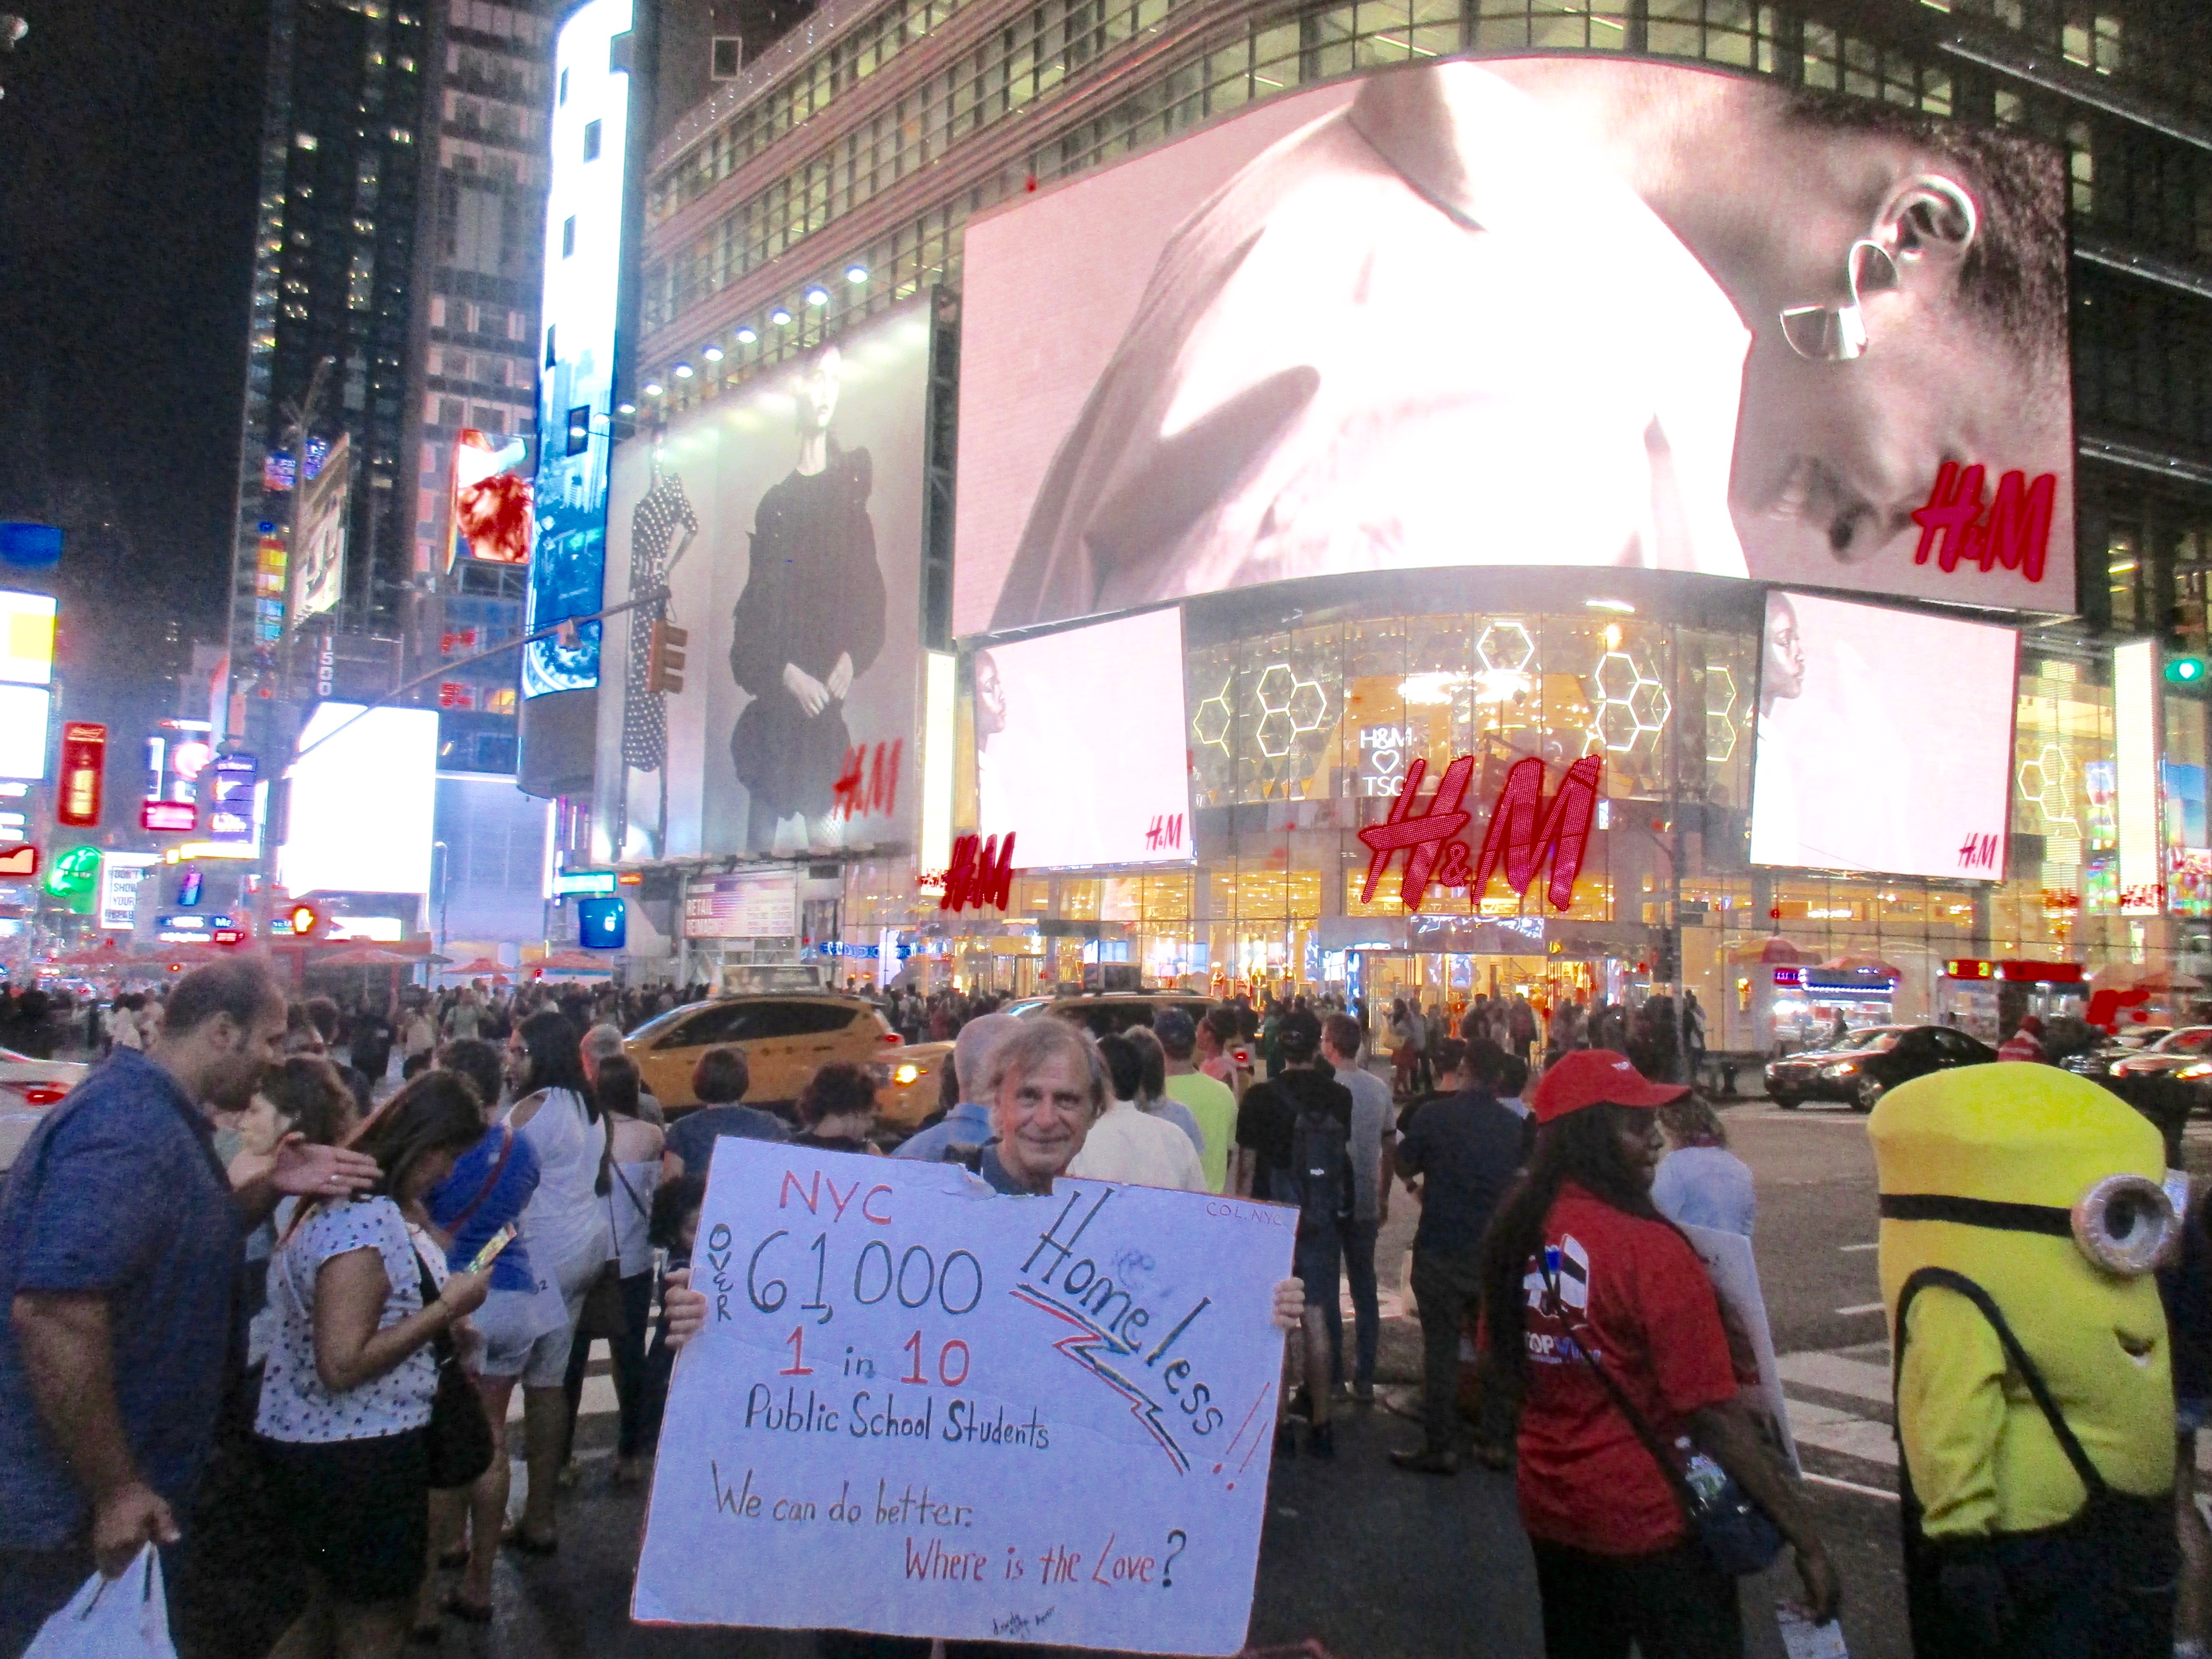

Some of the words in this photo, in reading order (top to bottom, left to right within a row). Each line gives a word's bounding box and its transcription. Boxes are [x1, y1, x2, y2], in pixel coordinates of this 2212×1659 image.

[1911, 462, 2055, 583] H&M
[1360, 727, 1413, 749] H&M
[1146, 813, 1183, 851] H&M
[1358, 754, 1601, 912] H&M
[1958, 833, 1998, 869] H&M
[778, 1170, 893, 1225] NYC
[708, 1223, 734, 1322] OVER
[747, 1230, 983, 1325] 61,000
[780, 1325, 814, 1376] 1
[844, 1346, 875, 1379] in
[901, 1329, 971, 1387] 10
[745, 1382, 839, 1432] Public
[849, 1390, 933, 1440] School
[943, 1399, 1051, 1449] Students
[711, 1459, 762, 1518] We
[773, 1498, 816, 1522] can
[829, 1480, 862, 1523] do
[905, 1537, 988, 1581] Where
[1006, 1546, 1025, 1580] is
[1039, 1544, 1081, 1585] the
